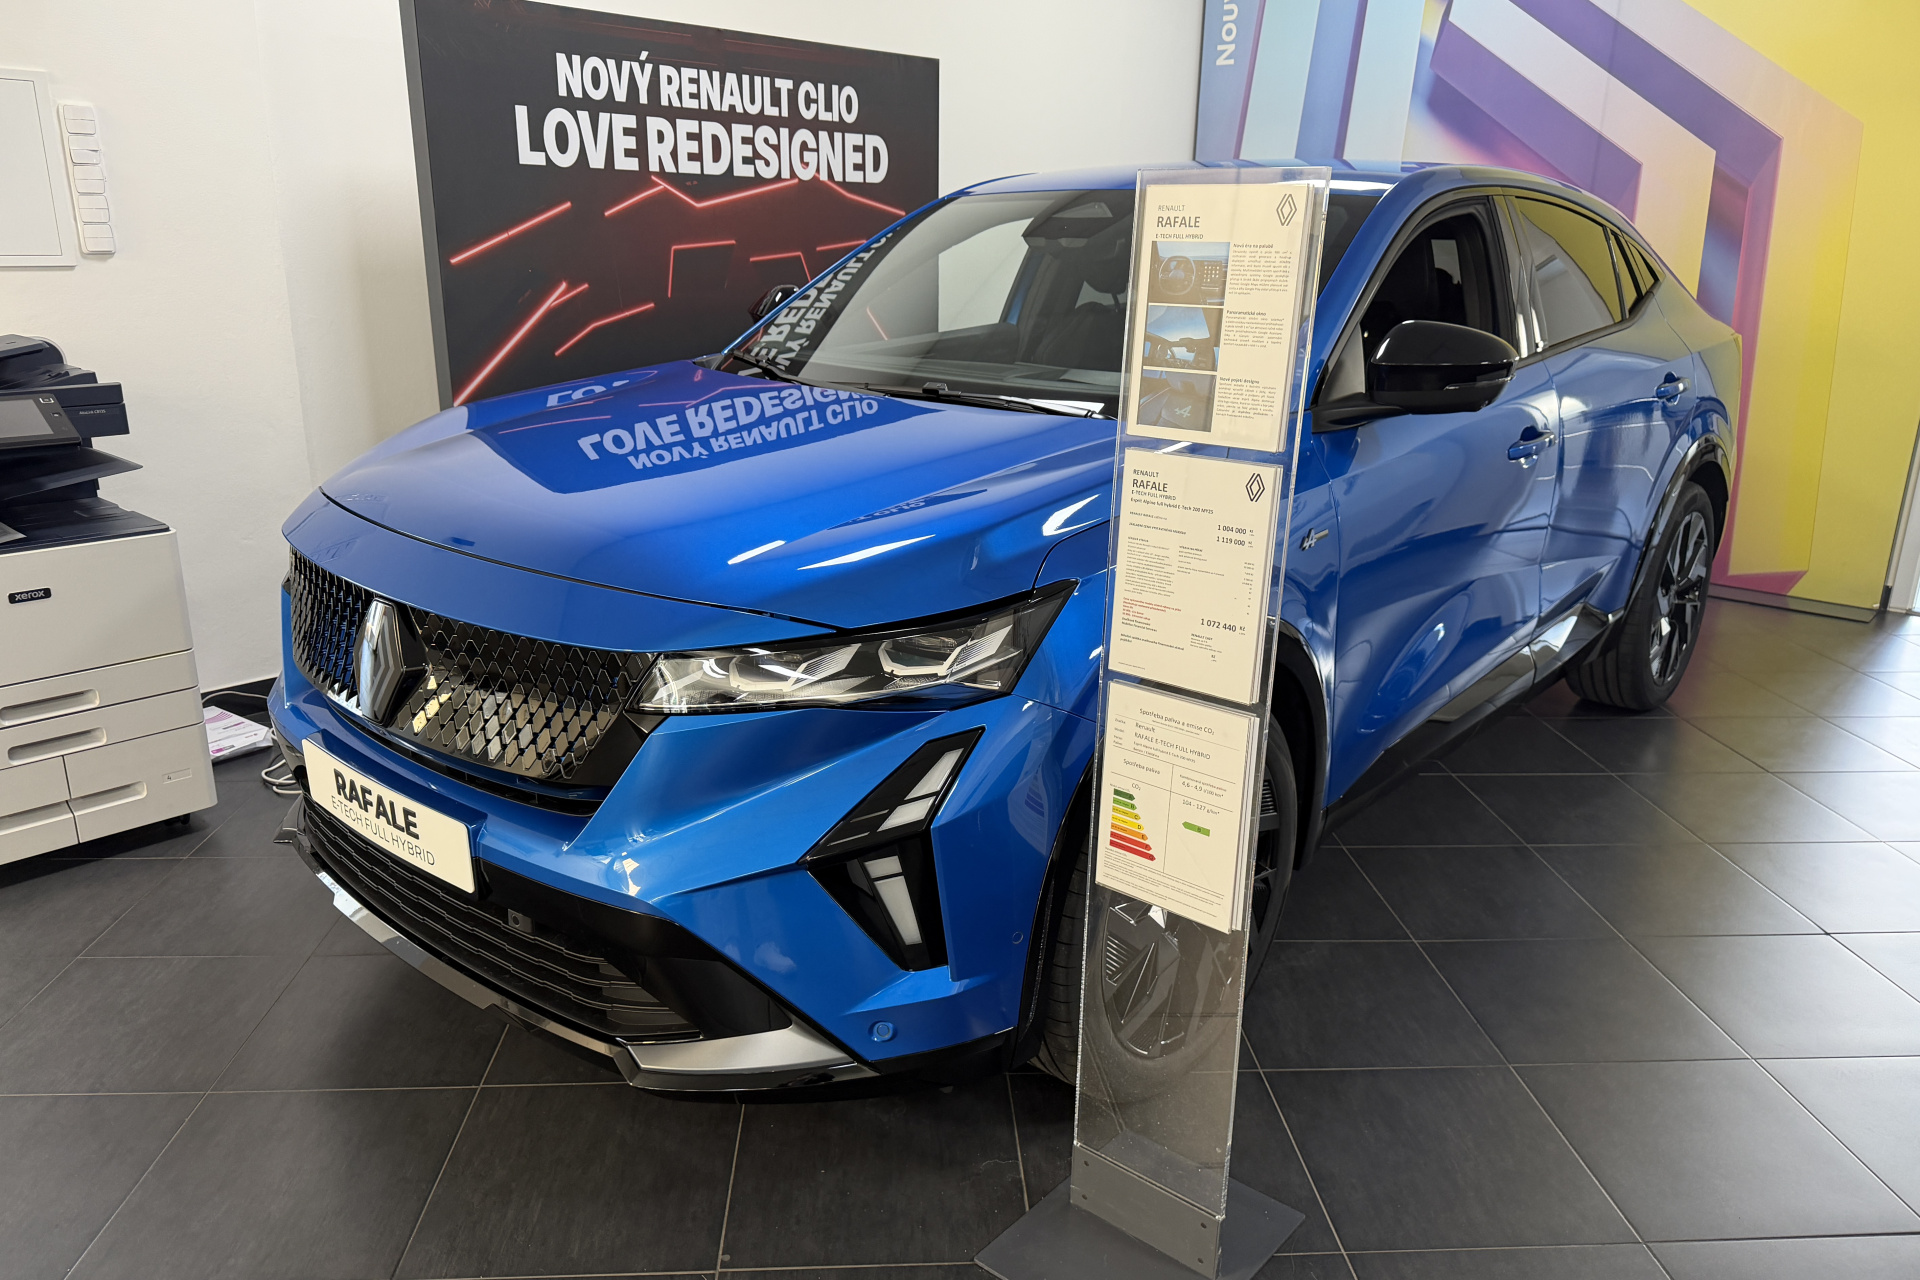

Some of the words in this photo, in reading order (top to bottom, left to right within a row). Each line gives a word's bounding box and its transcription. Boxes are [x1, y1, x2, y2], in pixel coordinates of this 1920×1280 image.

[1216, 0, 1238, 65] Nou
[556, 51, 653, 105] NOVÝ
[659, 65, 793, 118] RENAULT
[798, 81, 859, 124] CLIO
[514, 104, 640, 172] LOVE
[646, 115, 889, 184] REDESIGNED
[1156, 216, 1200, 228] RAFALE
[1133, 469, 1159, 478] RENAULT
[1132, 479, 1168, 492] RAFALE
[1159, 492, 1176, 500] HYBRID
[15, 590, 45, 600] xerox
[1206, 620, 1220, 629] 072
[1222, 623, 1236, 632] 440
[1136, 722, 1156, 733] Renault
[1140, 708, 1163, 720] Spotřeba
[1164, 715, 1180, 725] paliva
[1186, 723, 1202, 732] emise
[1135, 732, 1153, 742] RAFALE
[1155, 739, 1174, 749] E-TECH
[1176, 745, 1189, 753] FULL
[1190, 749, 1210, 760] HYBRID
[1123, 758, 1145, 771] Spotřeba
[1146, 766, 1160, 775] paliva
[334, 768, 420, 840] RAFALE
[331, 796, 363, 827] E-TECH
[365, 817, 390, 843] FULL
[391, 832, 435, 866] HYBRID
